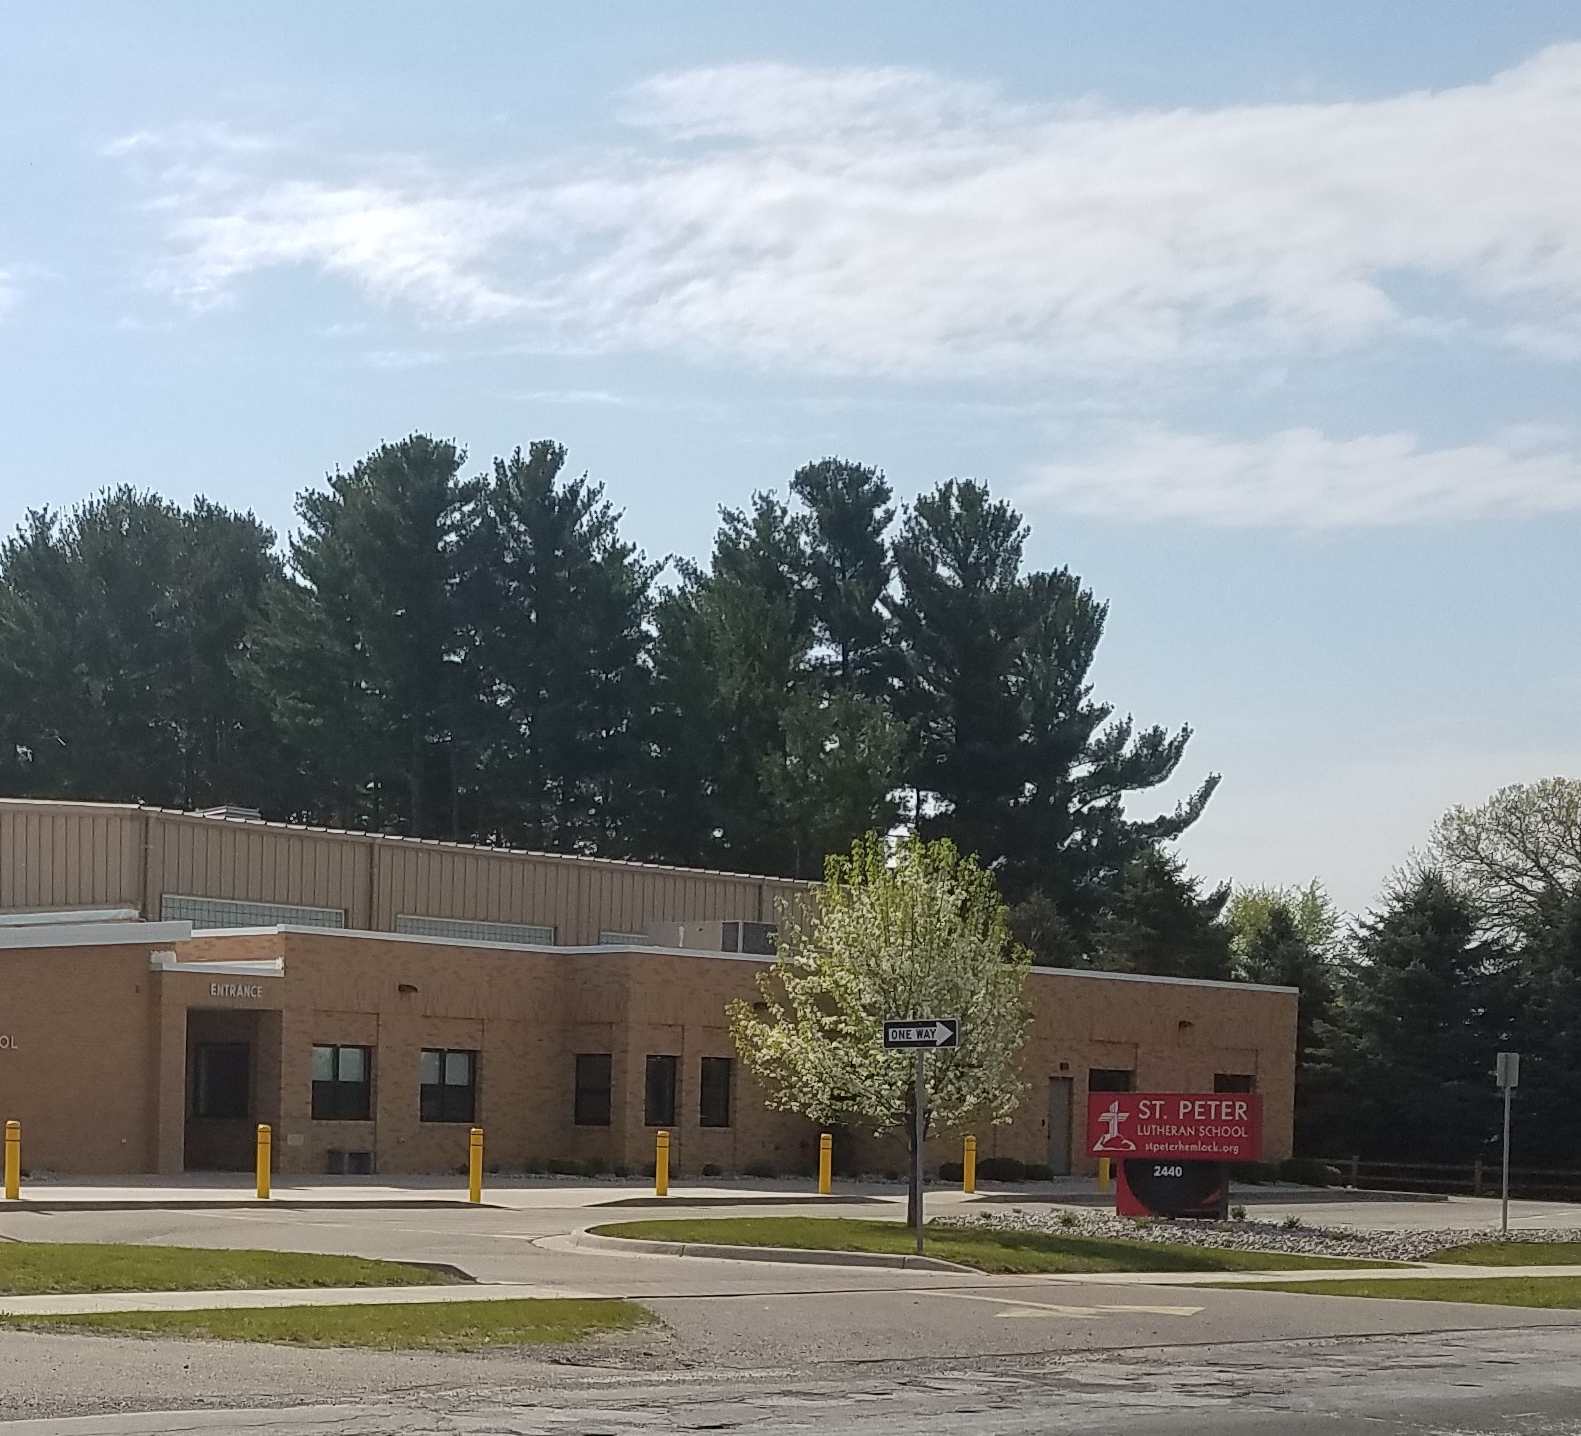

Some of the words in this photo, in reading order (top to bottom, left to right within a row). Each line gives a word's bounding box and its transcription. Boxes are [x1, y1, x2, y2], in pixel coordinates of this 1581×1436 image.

[210, 983, 263, 998] ENTRANCE
[891, 1029, 912, 1040] ONE
[916, 1028, 937, 1040] WAY
[1138, 1099, 1168, 1120] ST.
[1179, 1100, 1248, 1121] PETER
[1137, 1124, 1196, 1137] LUTHERAN
[1199, 1125, 1248, 1138] SCHOOL
[1145, 1140, 1239, 1155] stpeterhemlock.org
[1153, 1165, 1183, 1177] 2440
